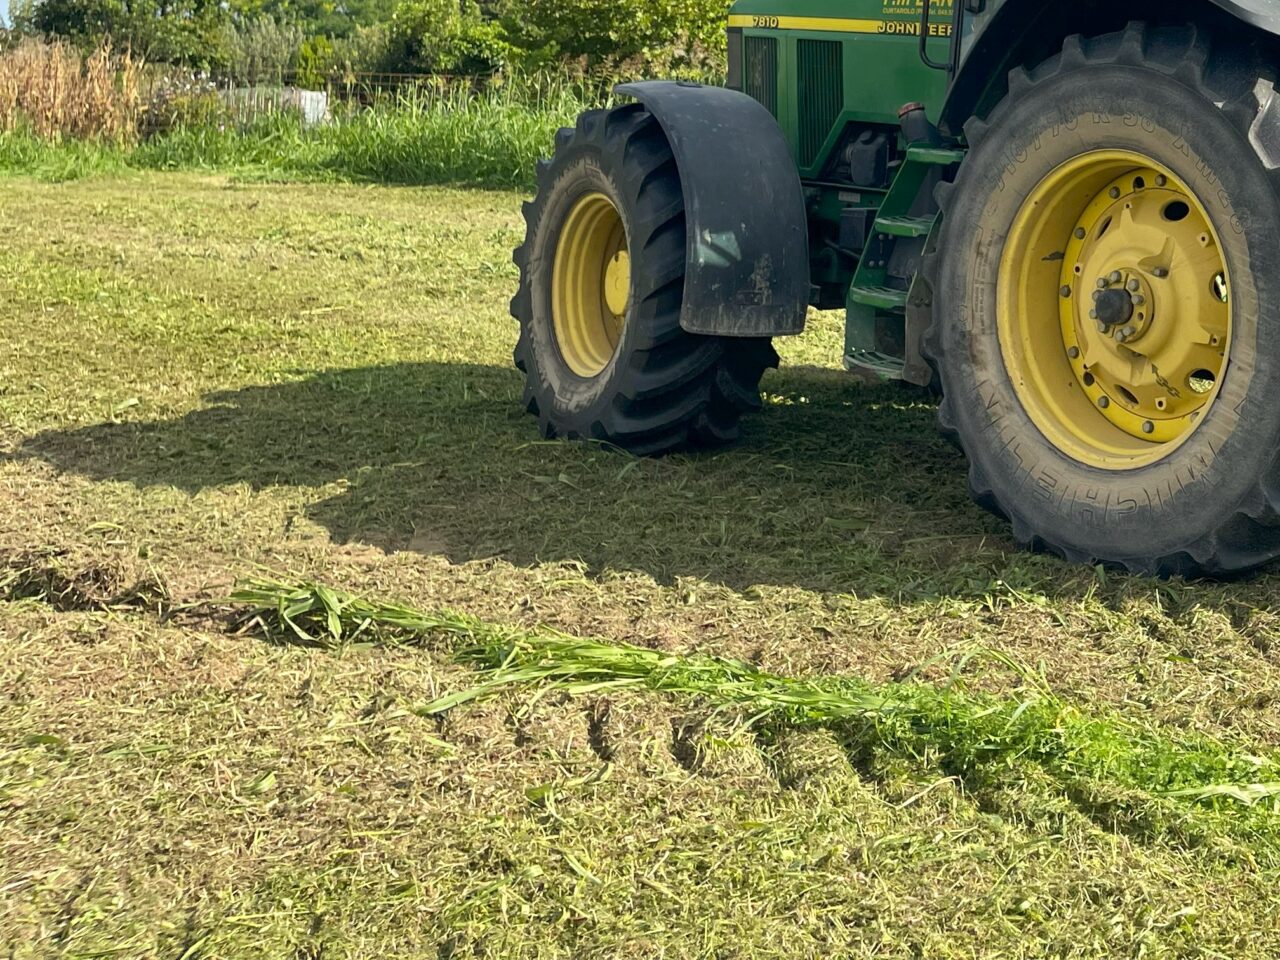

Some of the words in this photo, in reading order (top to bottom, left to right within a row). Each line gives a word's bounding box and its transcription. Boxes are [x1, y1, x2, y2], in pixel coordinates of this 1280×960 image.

[753, 16, 779, 28] 7810
[878, 21, 915, 35] JOHN
[968, 381, 1220, 526] MICHELIN
